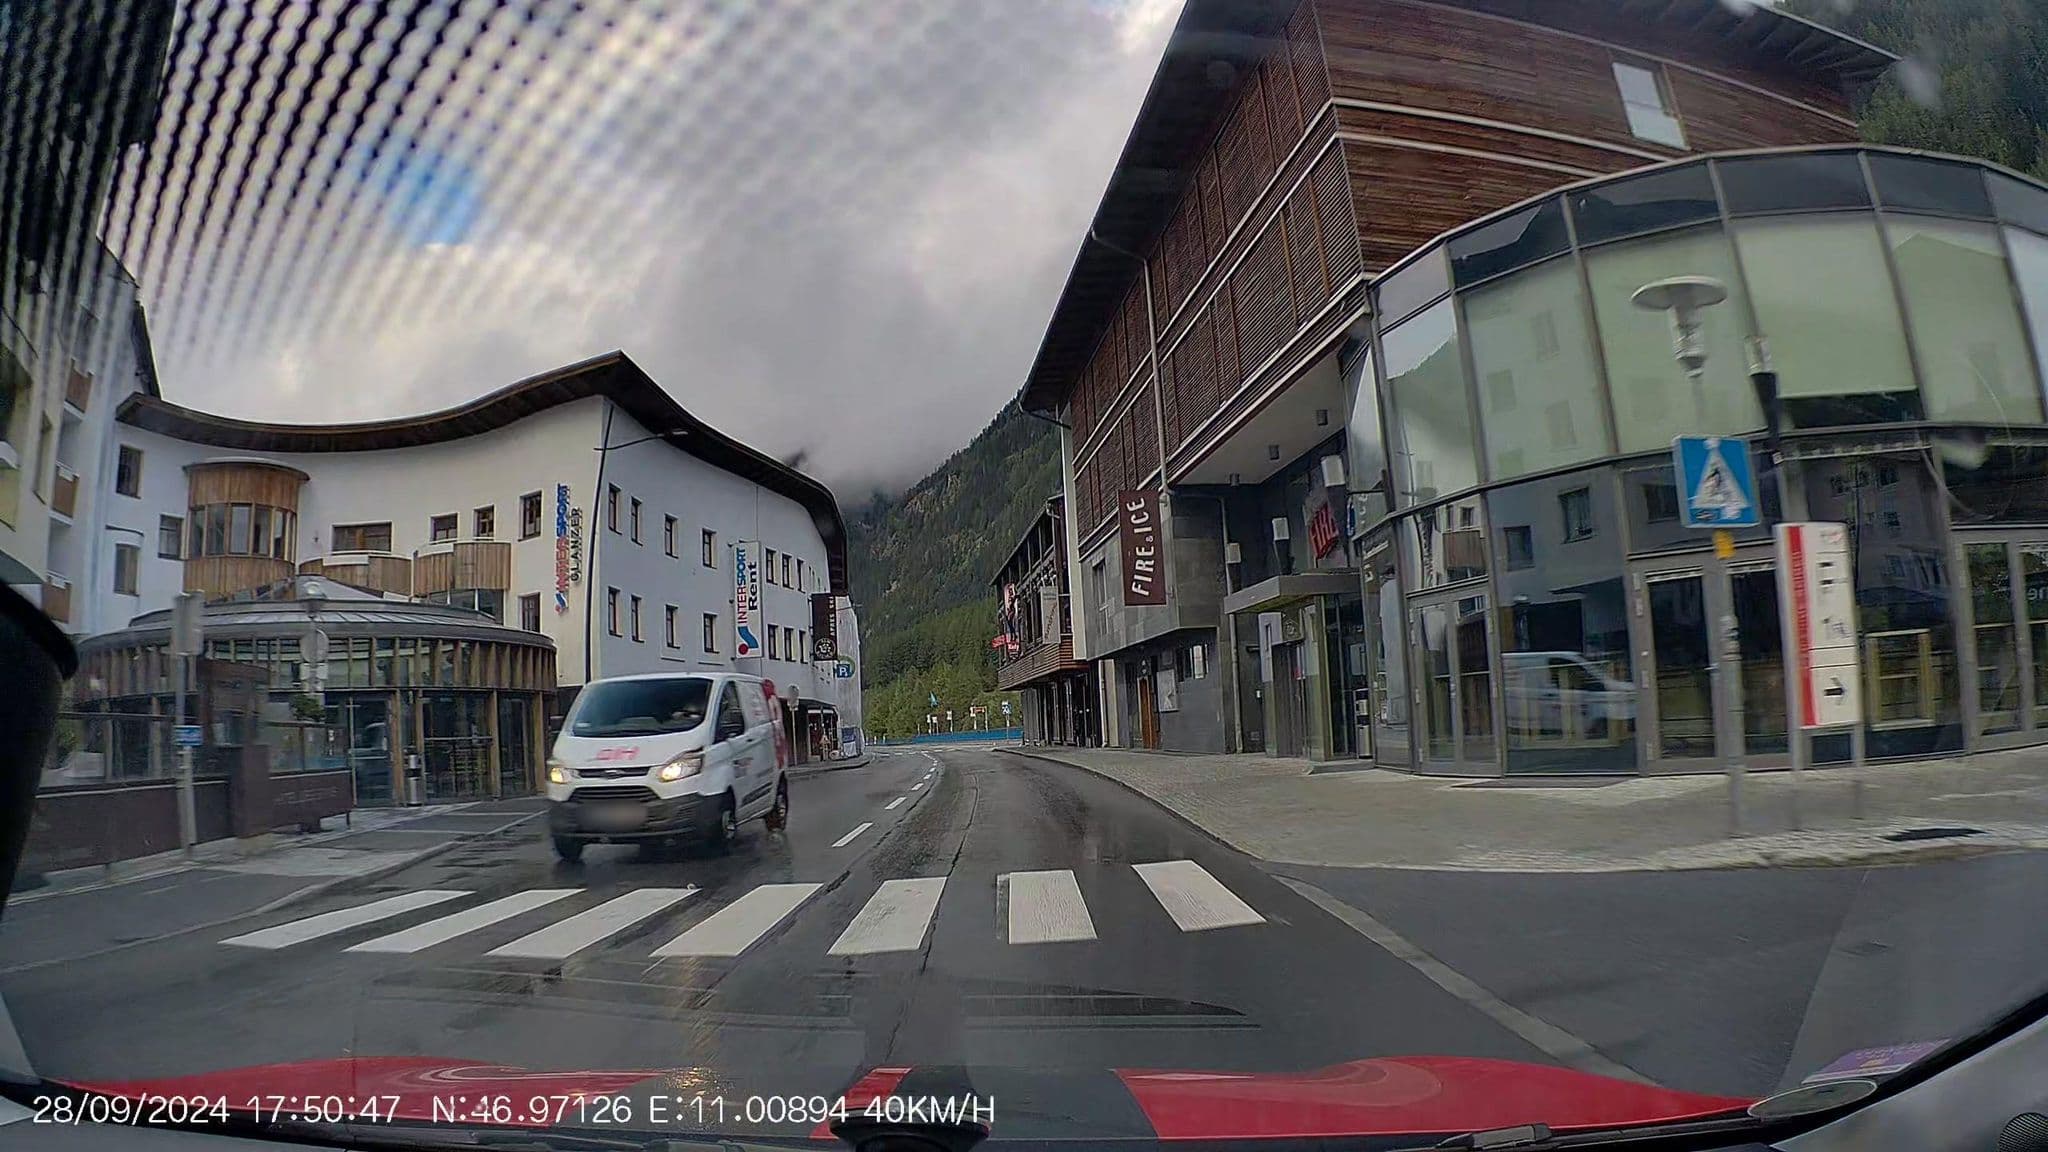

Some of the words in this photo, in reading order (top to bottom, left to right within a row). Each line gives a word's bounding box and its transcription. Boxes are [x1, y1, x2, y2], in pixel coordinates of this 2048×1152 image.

[555, 482, 569, 593] INTERSPORT
[570, 507, 581, 582] GLANZER
[1126, 497, 1153, 534] ICE
[736, 547, 748, 624] INTERSPORT
[747, 561, 758, 611] Rent
[1131, 546, 1155, 596] FIRE
